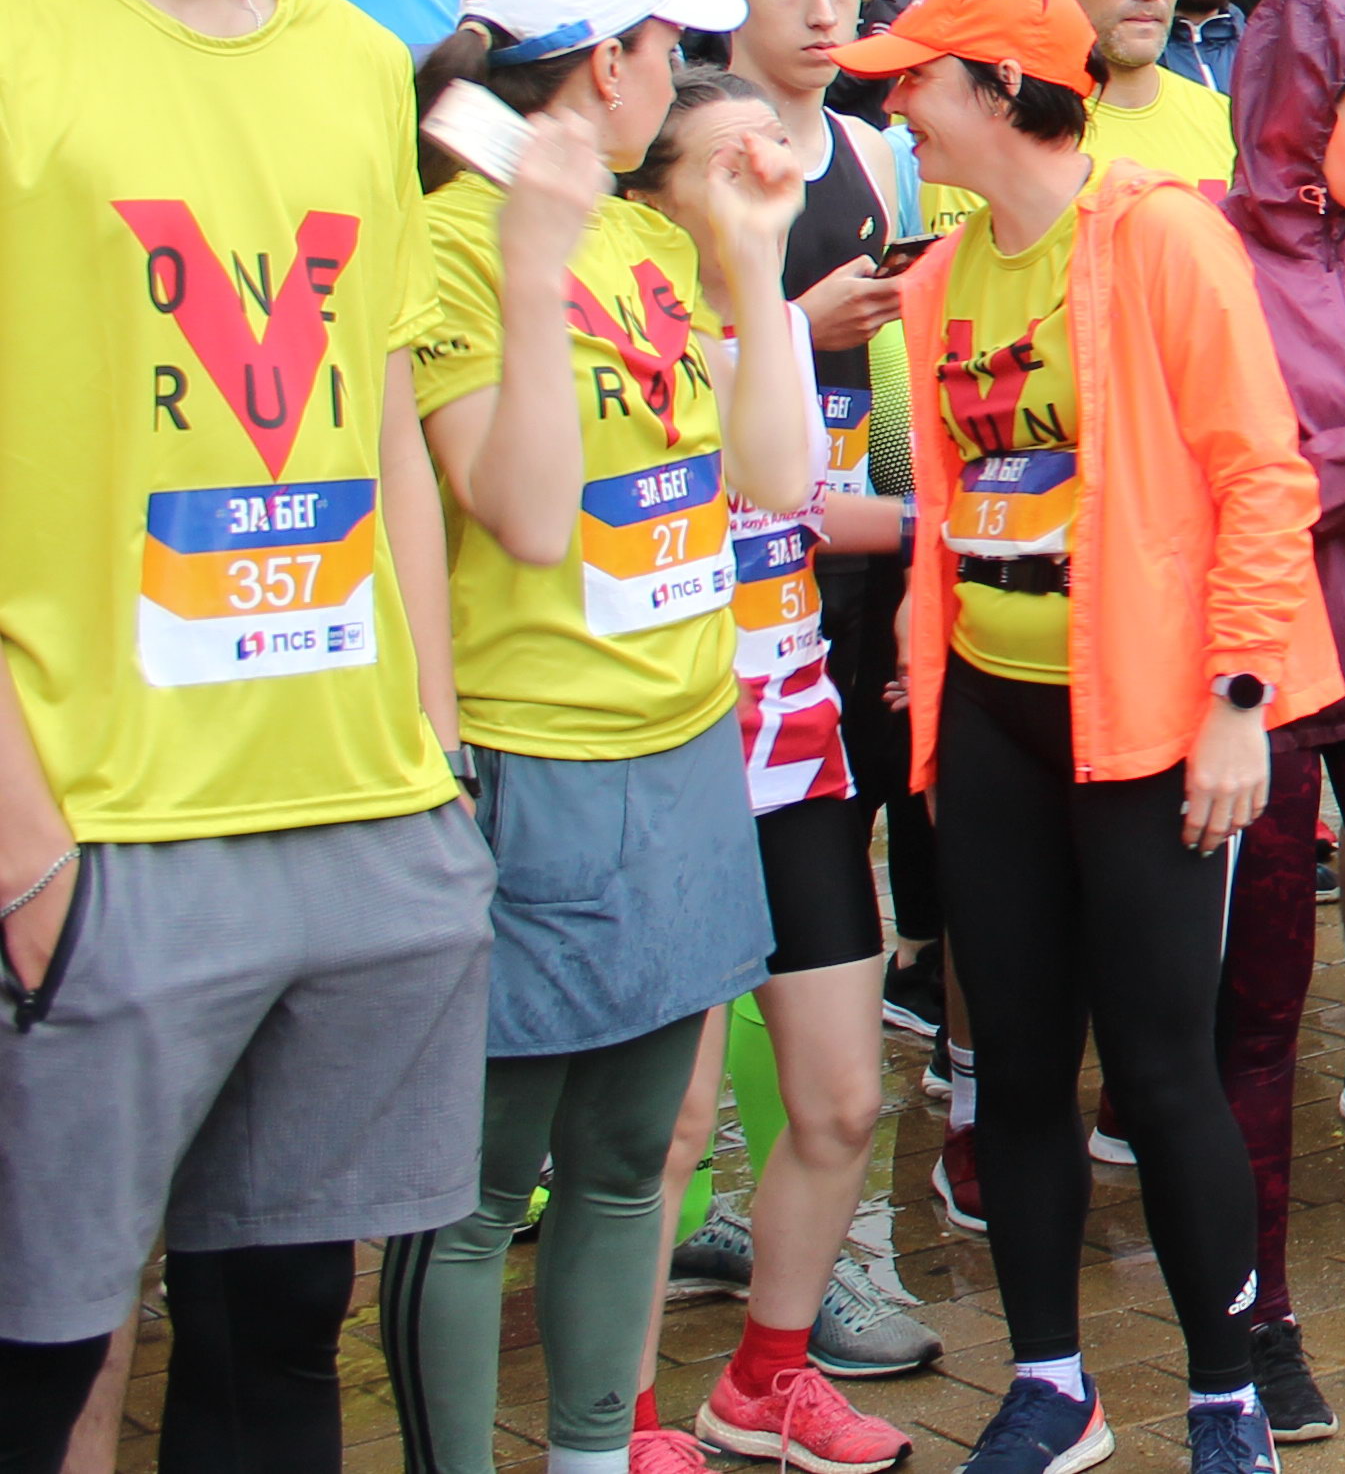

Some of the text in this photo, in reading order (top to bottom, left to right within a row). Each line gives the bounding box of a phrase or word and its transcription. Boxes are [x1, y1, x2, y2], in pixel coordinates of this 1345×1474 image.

[147, 245, 341, 322] ONE
[976, 499, 1009, 536] 13
[652, 519, 689, 566] 27
[227, 554, 322, 609] 357
[671, 578, 702, 600] ПСБ
[781, 578, 806, 619] 51
[272, 630, 316, 652] ПСБ
